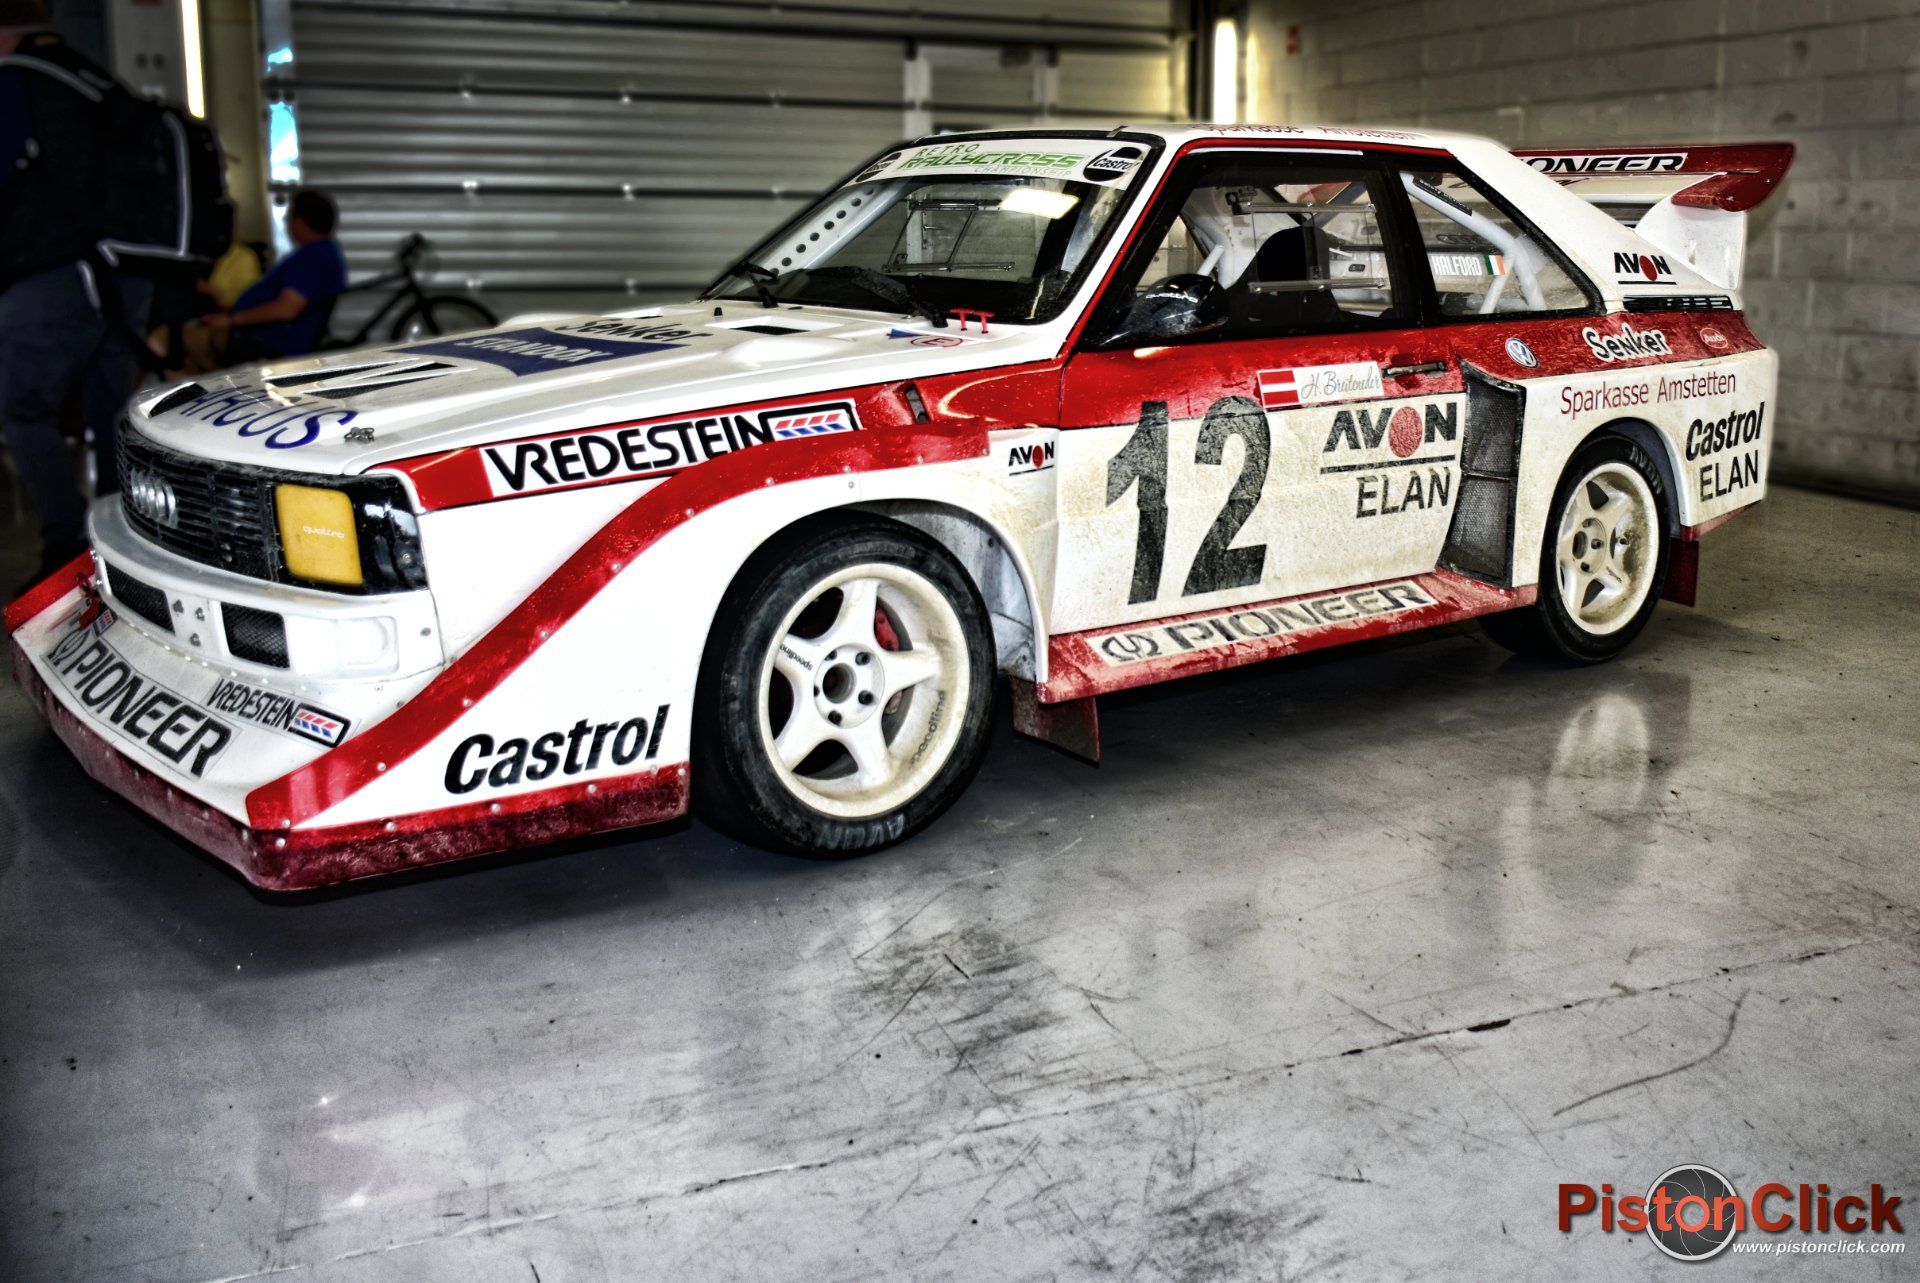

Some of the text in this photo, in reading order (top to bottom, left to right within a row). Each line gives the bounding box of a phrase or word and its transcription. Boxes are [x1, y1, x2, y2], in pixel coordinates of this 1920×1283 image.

[898, 152, 1086, 169] RALLYCROSS
[914, 143, 980, 157] RETRO
[1432, 256, 1482, 276] HALFORD
[1614, 252, 1672, 281] AVON
[1560, 371, 1736, 419] Sparkasse Amstetten
[485, 413, 776, 491] VREDESTEIN
[1009, 441, 1054, 468] AVON
[1322, 402, 1457, 458] AVON
[1686, 402, 1766, 462] Castrol
[1106, 395, 1271, 605] 12
[1356, 467, 1451, 518] ELAN
[1700, 449, 1759, 502] ELAN
[1164, 584, 1430, 650] PIONEER
[62, 639, 232, 778] PIONEER
[206, 678, 302, 731] VREDESTEIN
[444, 704, 671, 795] Castrol
